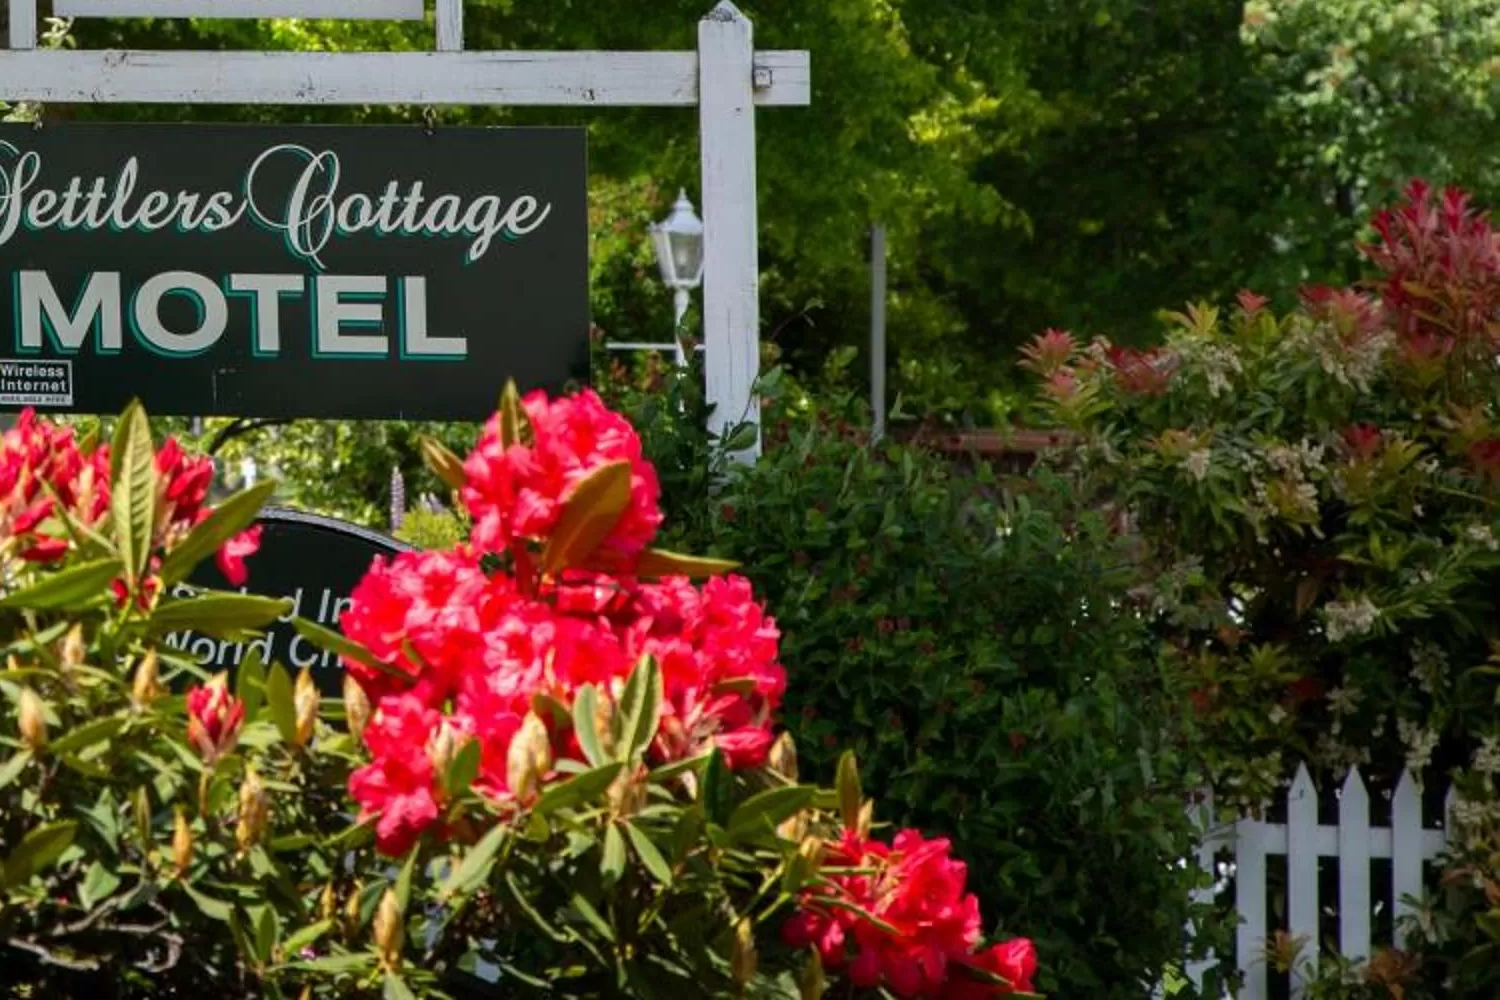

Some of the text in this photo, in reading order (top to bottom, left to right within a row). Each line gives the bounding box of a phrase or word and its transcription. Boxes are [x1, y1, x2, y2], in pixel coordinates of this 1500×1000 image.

[246, 143, 550, 268] Cottage
[15, 270, 468, 360] MOTEL
[0, 363, 65, 378] Wireless
[0, 378, 67, 393] Internet
